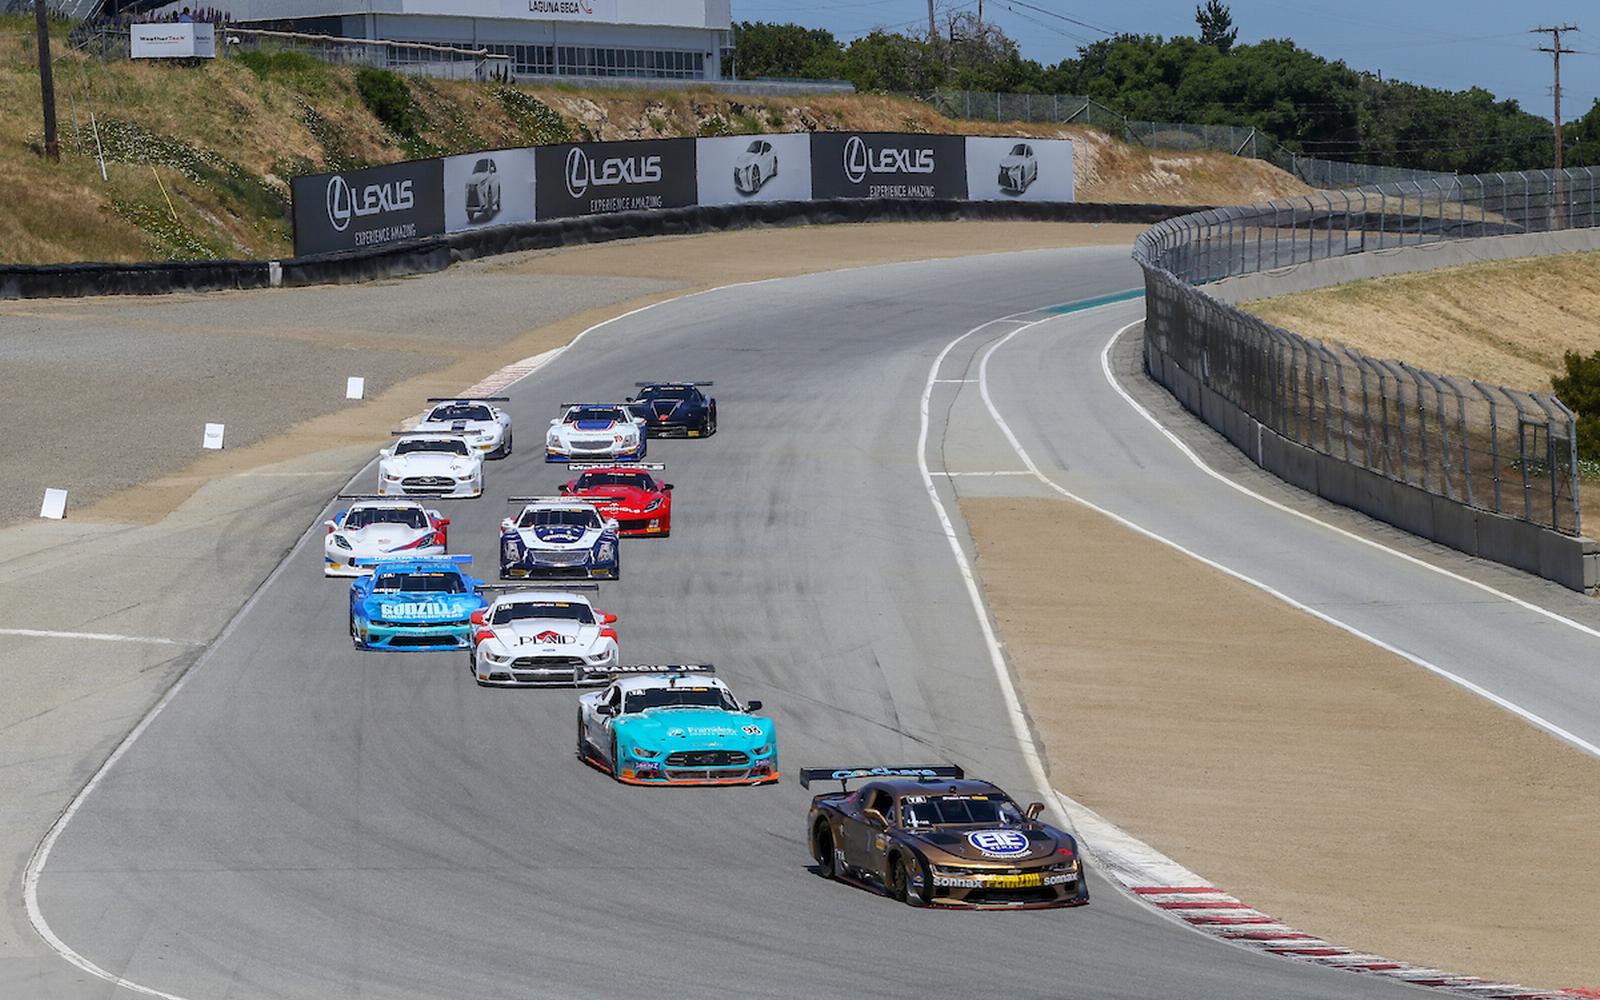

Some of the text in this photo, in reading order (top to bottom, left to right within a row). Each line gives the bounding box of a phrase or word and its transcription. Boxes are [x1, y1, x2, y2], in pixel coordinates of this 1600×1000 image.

[529, 0, 580, 13] LAGUNA SECA
[867, 147, 935, 173] LEXUS
[590, 156, 662, 186] LEXUS
[352, 179, 415, 217] LEXUS
[869, 185, 936, 198] EXPERIENCE AMAZING
[590, 195, 663, 212] EXPERIENCE AMAZING
[355, 223, 417, 246] EXPERIENCE AMAZING
[381, 602, 464, 615] GODZILLA
[519, 634, 577, 646] PLAID
[583, 664, 670, 673] FRANCIS
[932, 876, 983, 888] sonnax
[984, 872, 1041, 889] PENNZOIL
[1043, 872, 1079, 886] sonnax
